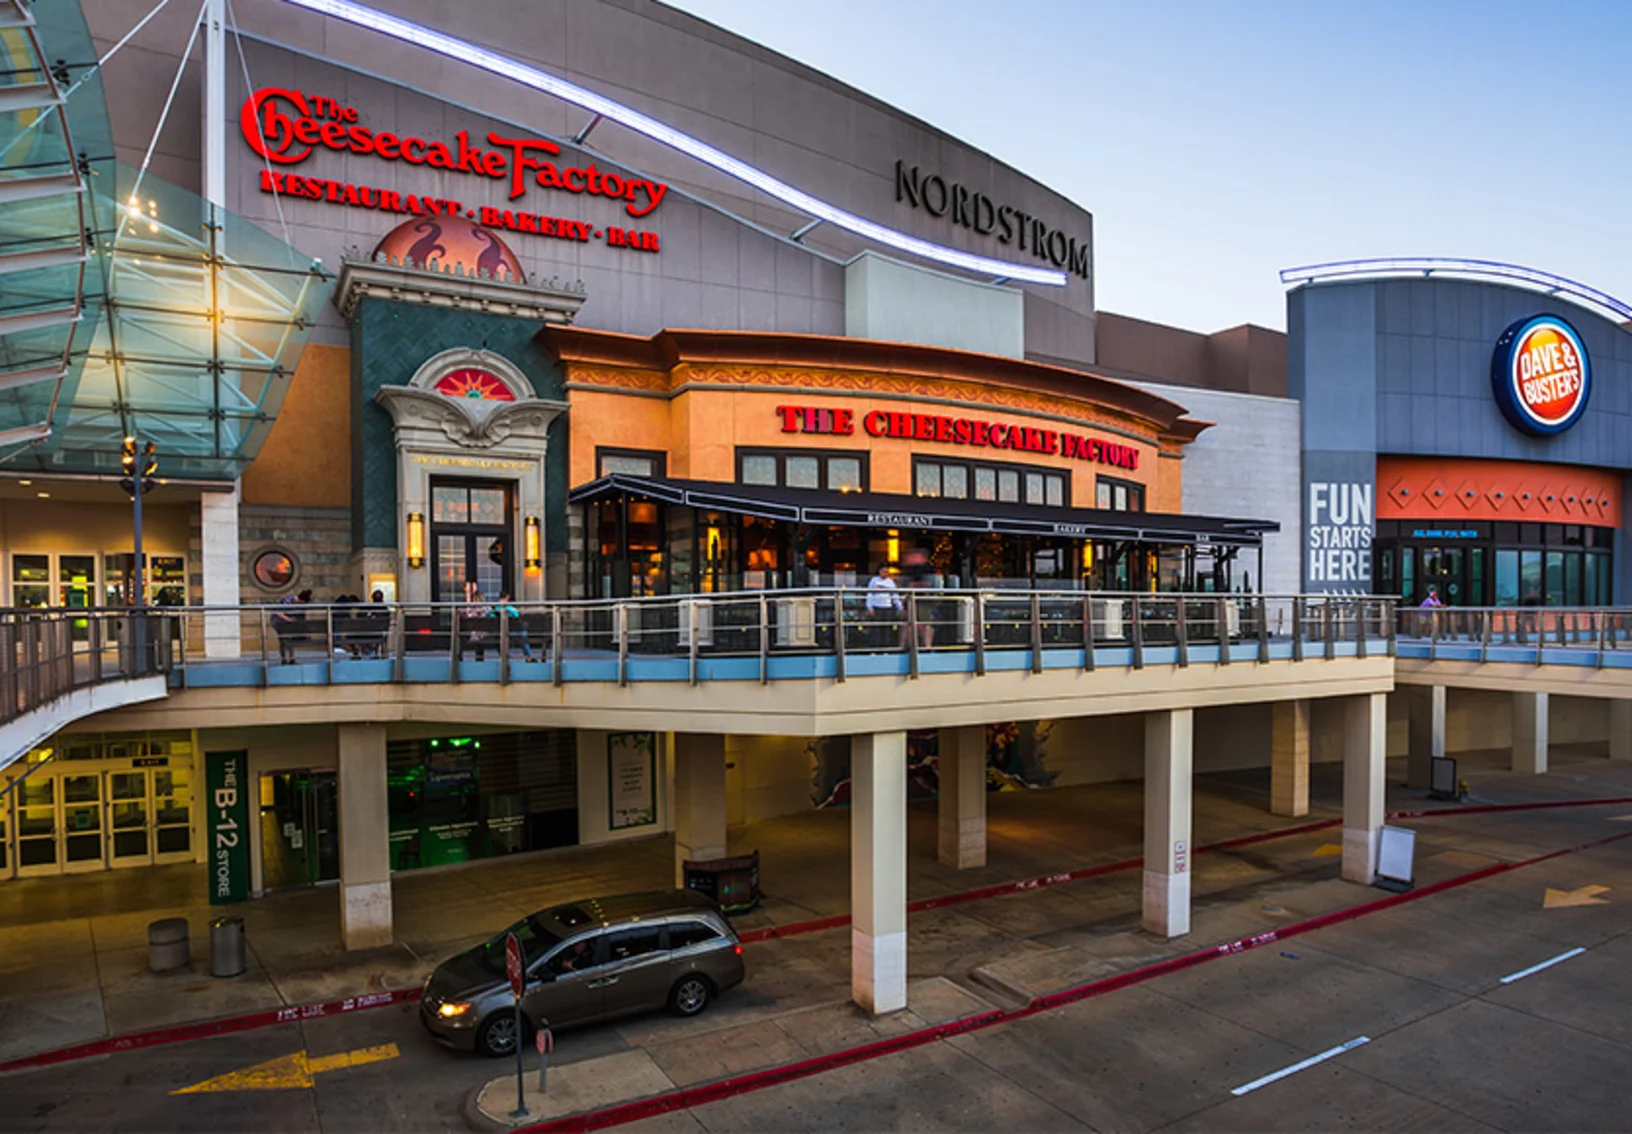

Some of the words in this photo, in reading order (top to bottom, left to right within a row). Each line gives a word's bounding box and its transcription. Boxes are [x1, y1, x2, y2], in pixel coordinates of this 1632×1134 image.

[310, 94, 358, 123] The
[240, 87, 507, 181] Cheesecake
[488, 131, 668, 217] Factory
[260, 169, 461, 219] RESTAURANT
[480, 205, 593, 242] BAKERY
[607, 225, 660, 252] BAR
[895, 159, 1088, 280] NORDSTROM
[1521, 343, 1564, 381] DAVE
[1561, 342, 1577, 368] &
[777, 405, 854, 436] THE
[865, 409, 1058, 456] CHEESECAKE
[1060, 432, 1140, 470] FACTORY
[1310, 482, 1372, 525] FUN
[1310, 525, 1371, 548] STARTS
[1310, 549, 1371, 581] HERE
[224, 758, 237, 787] THE
[215, 788, 239, 848] B-12
[216, 850, 230, 897] STORE
